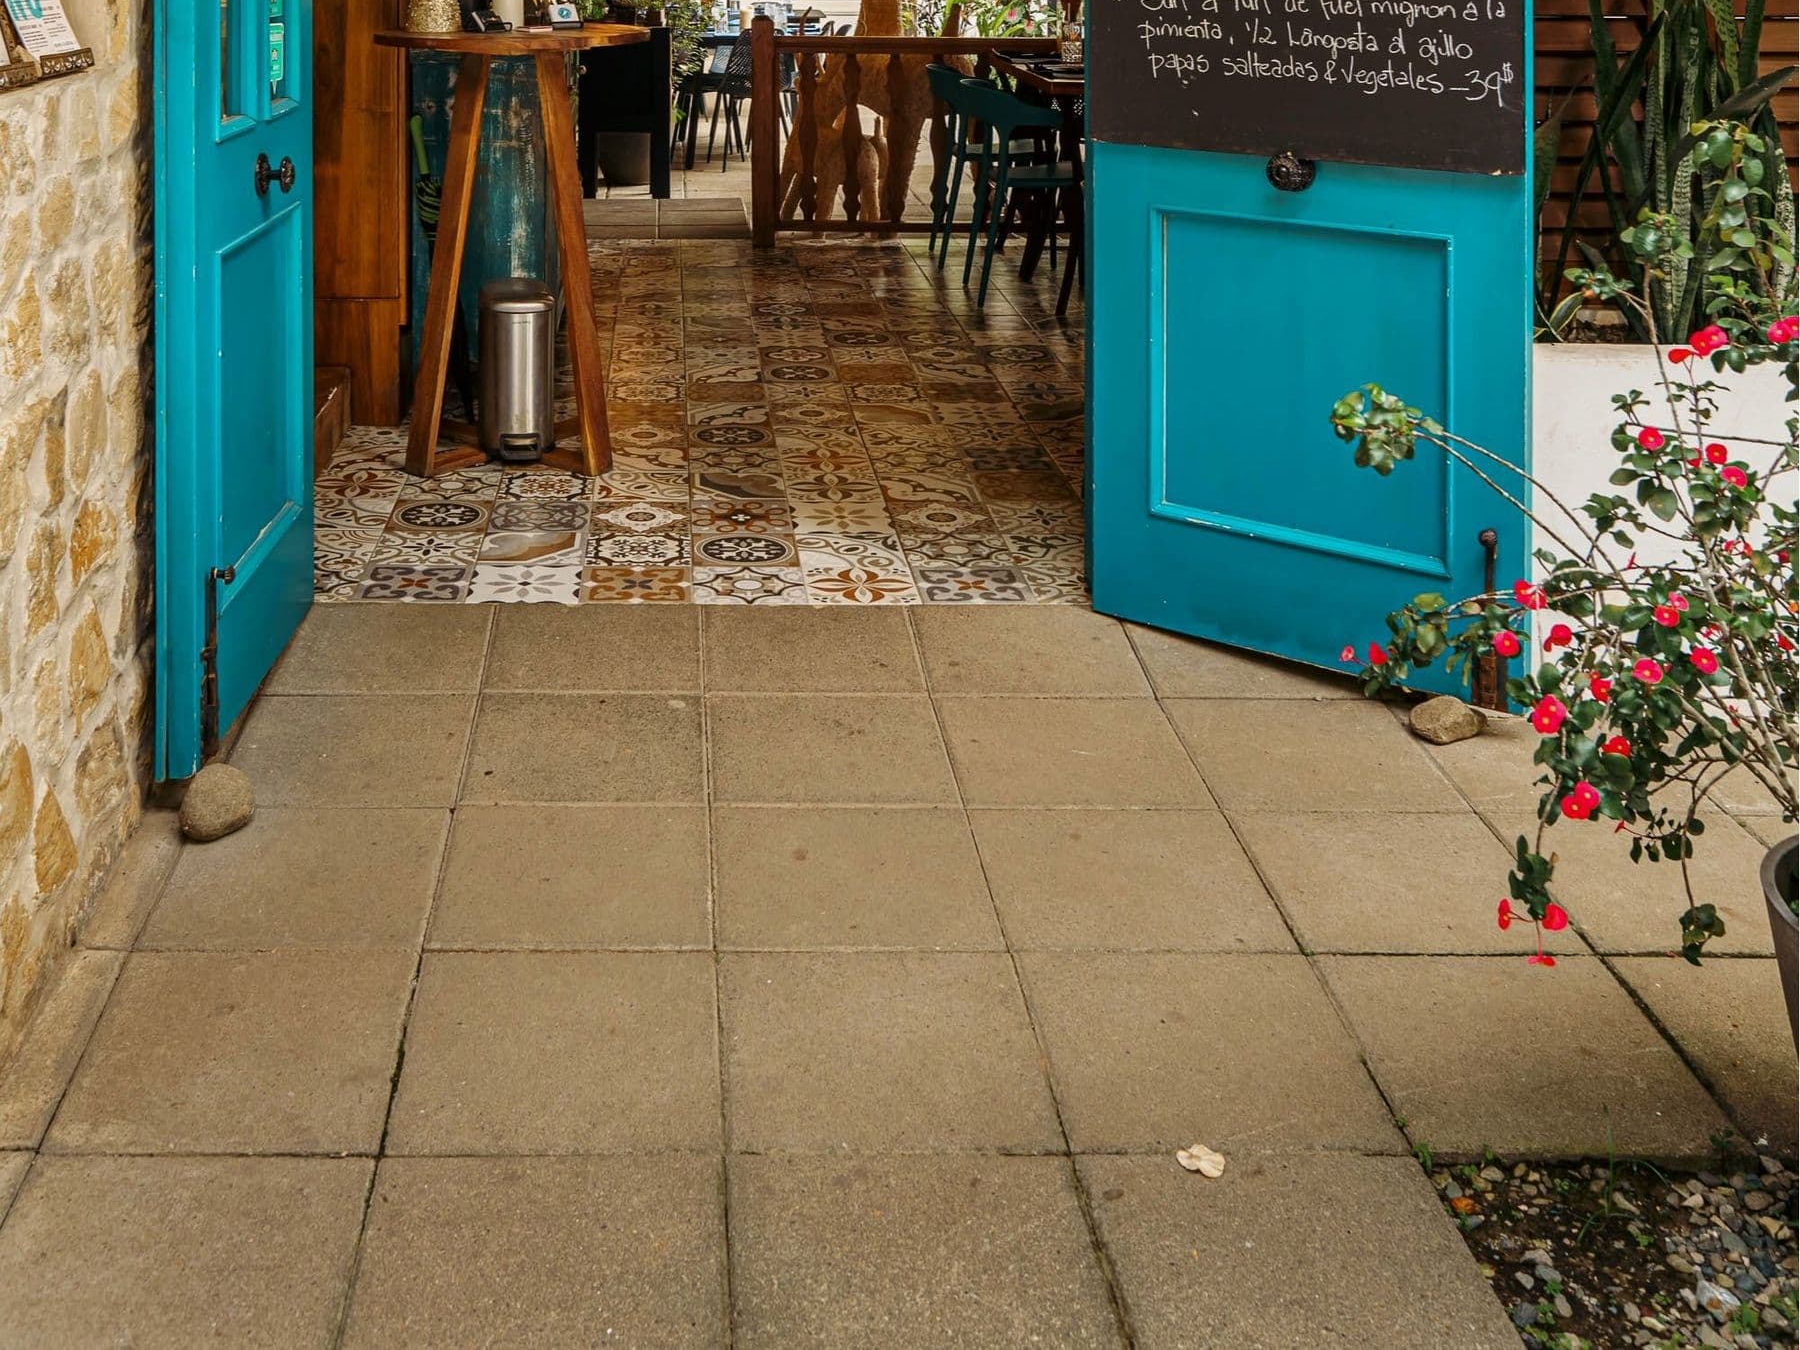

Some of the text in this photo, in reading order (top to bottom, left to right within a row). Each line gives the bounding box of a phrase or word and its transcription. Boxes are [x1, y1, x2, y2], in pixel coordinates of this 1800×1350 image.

[1462, 1, 1479, 22] a
[1418, 28, 1474, 66] ajillo
[1147, 52, 1210, 79] papas
